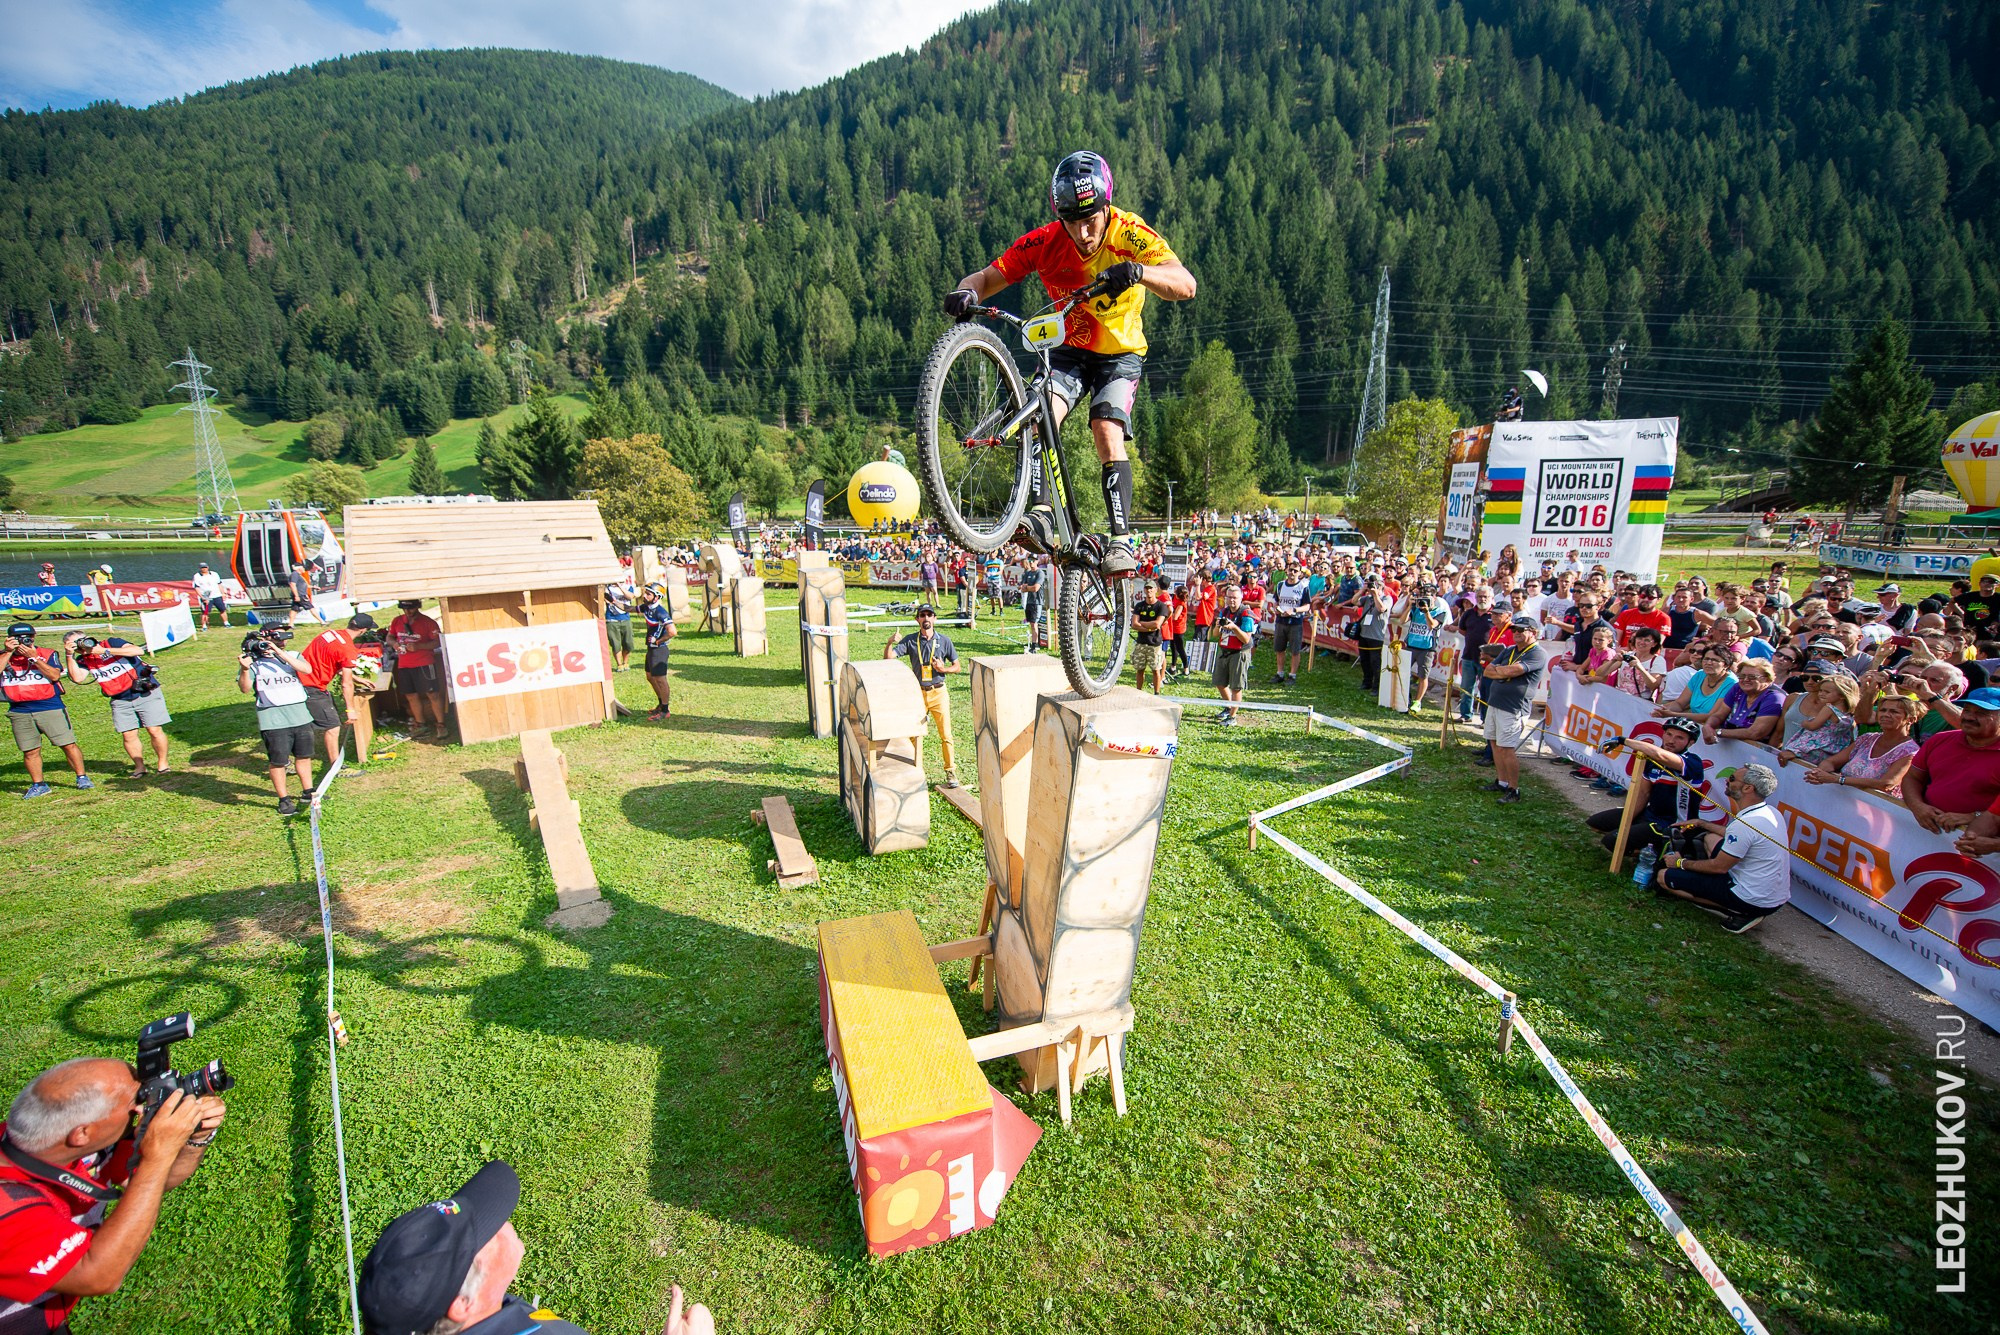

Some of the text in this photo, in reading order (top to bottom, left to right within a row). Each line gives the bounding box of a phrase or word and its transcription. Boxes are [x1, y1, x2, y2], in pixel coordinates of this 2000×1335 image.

[1074, 176, 1092, 187] NON
[1076, 184, 1093, 194] STOP
[1038, 325, 1048, 339] 4
[1970, 441, 1998, 458] Val
[1031, 459, 1041, 496] JITSIE
[1546, 473, 1614, 490] WORLD
[860, 488, 896, 498] Melinda
[1545, 493, 1610, 501] CHAMPIONSHIPS
[732, 506, 742, 520] 3
[810, 498, 821, 517] 4
[1110, 490, 1126, 529] JITSIE
[1448, 493, 1472, 518] 2017
[1544, 504, 1608, 527] 2016
[1529, 537, 1613, 547] DHI 4X TRIALS
[1914, 555, 1970, 572] PEJO
[872, 565, 892, 581] Val
[0, 591, 53, 606] TRENTINO
[105, 588, 136, 606] Val
[136, 594, 149, 605] di
[152, 587, 191, 604] Sole
[456, 640, 587, 689] di Sole
[274, 675, 297, 684] HOS
[1561, 745, 1627, 787] IPERCONVENIENZA
[1782, 808, 1876, 892] IPER
[1791, 873, 1900, 943] RCONVENIENZA
[1908, 938, 1967, 979] TUTTI
[59, 1173, 94, 1194] Canon
